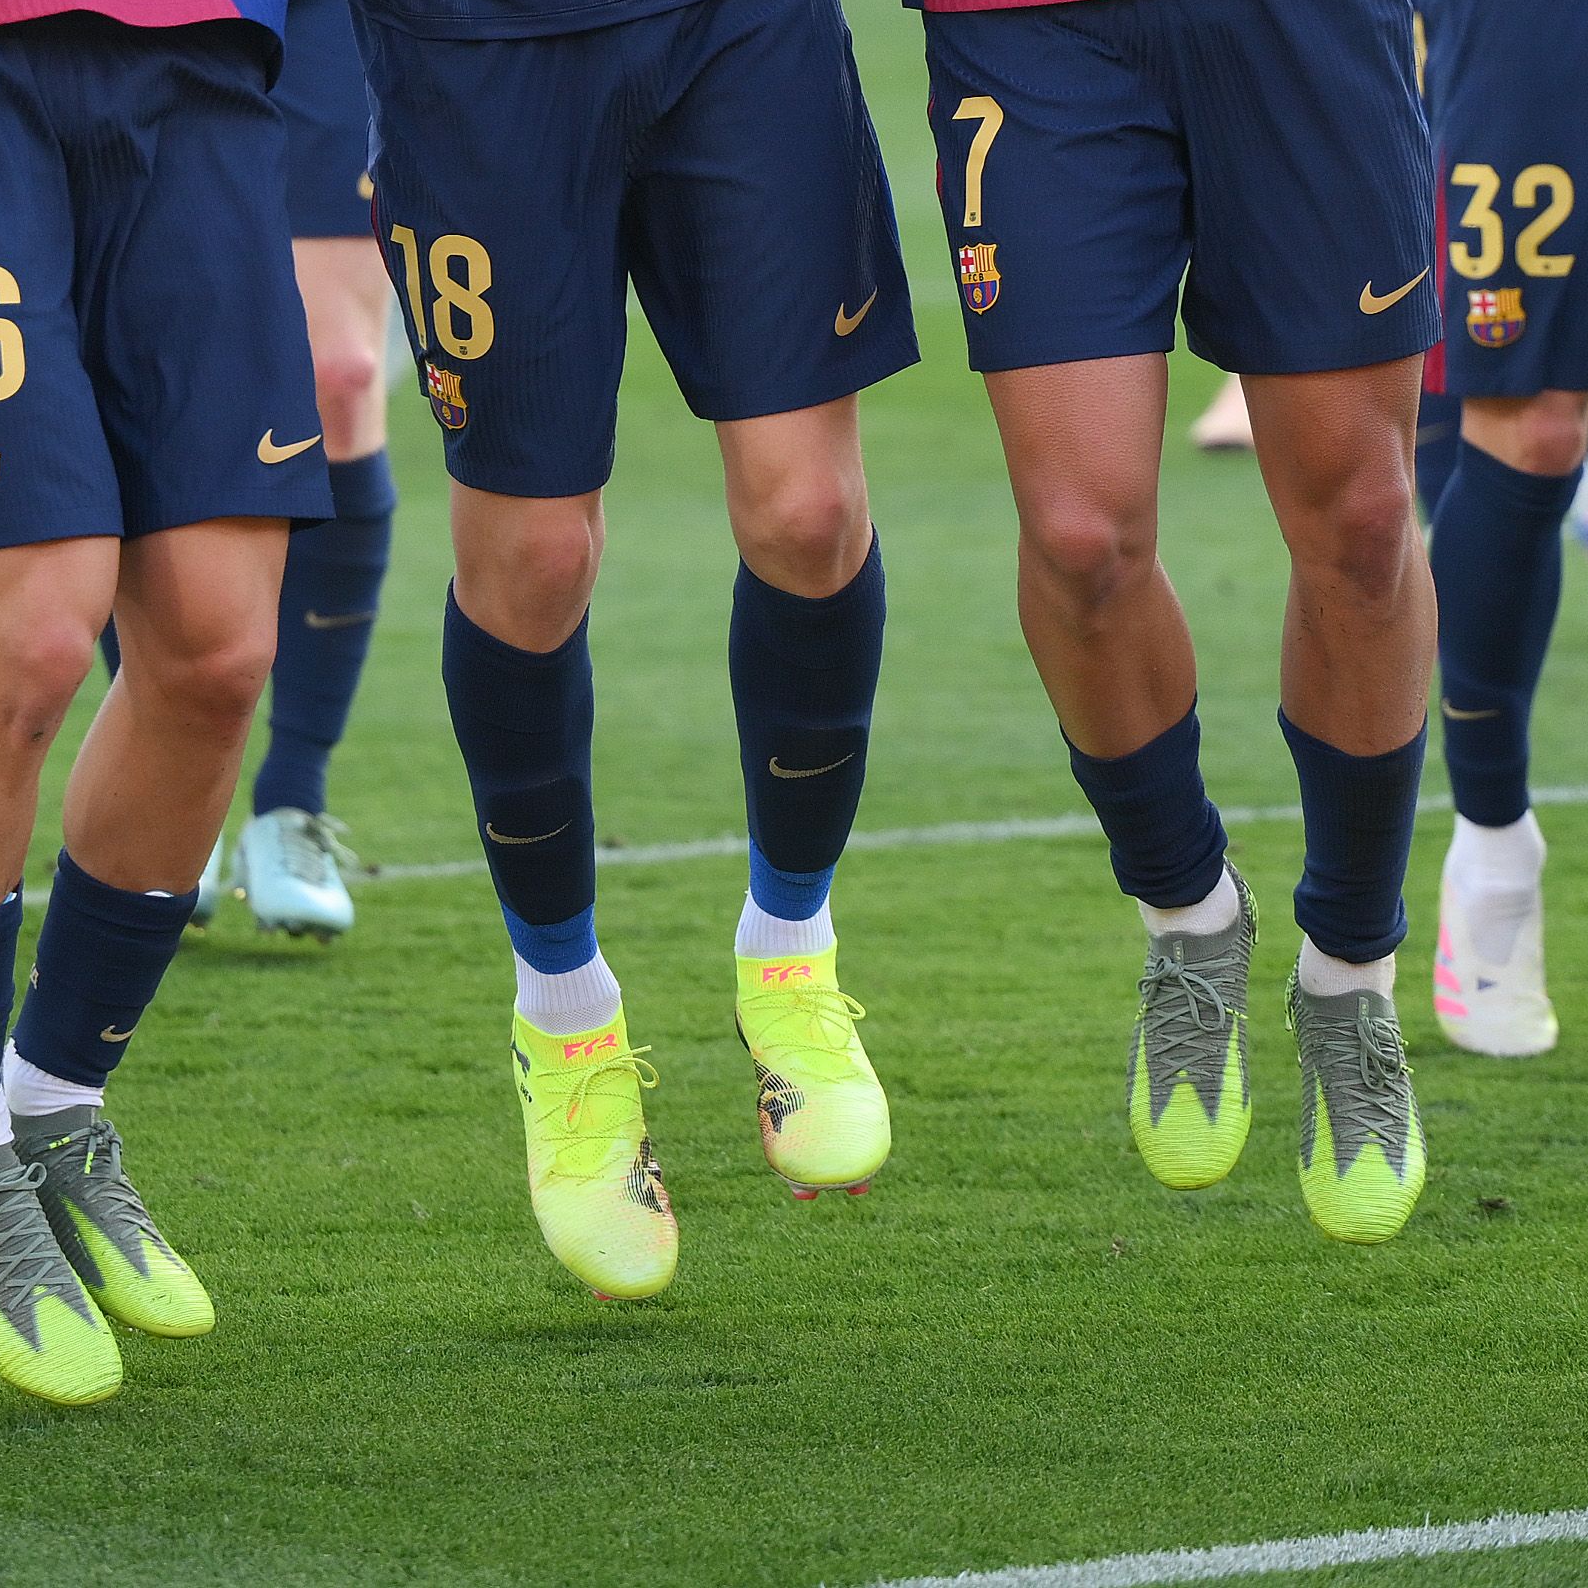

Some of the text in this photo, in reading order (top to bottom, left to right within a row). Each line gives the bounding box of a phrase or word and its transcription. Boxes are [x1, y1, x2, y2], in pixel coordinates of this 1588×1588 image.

[952, 95, 1004, 228] 7
[1448, 163, 1576, 280] 32
[390, 223, 495, 360] 18
[967, 273, 985, 282] FCB
